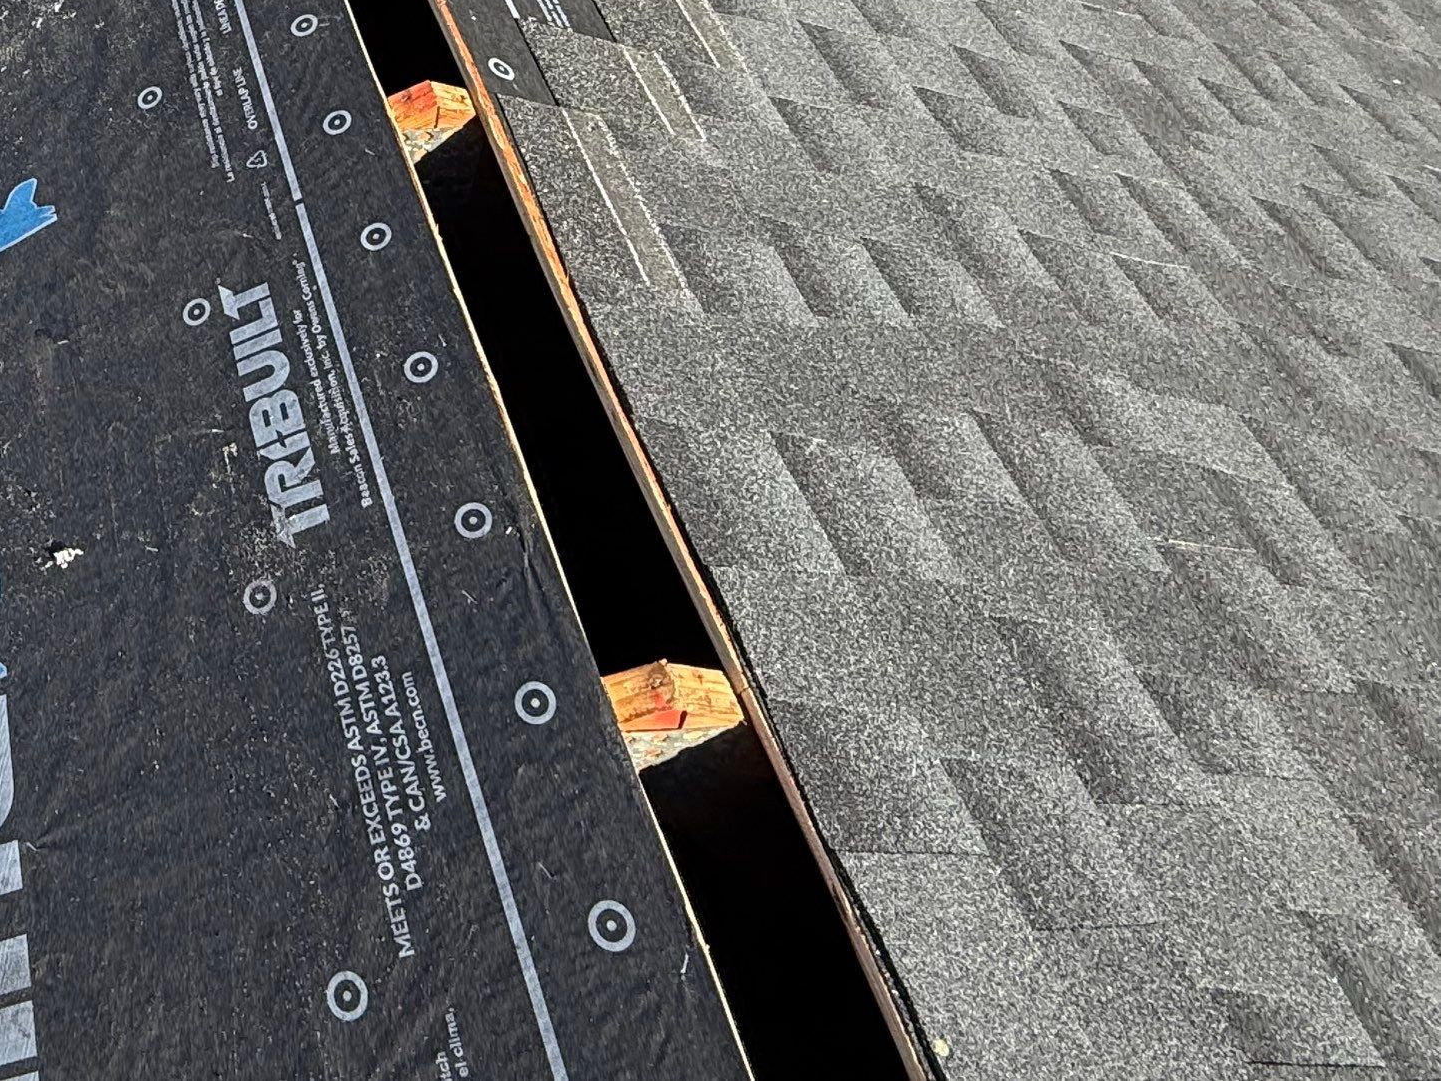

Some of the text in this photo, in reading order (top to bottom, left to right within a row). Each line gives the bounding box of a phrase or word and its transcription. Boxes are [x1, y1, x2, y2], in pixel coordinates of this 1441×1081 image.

[232, 67, 257, 129] OVERLAP LINE
[305, 300, 321, 333] Owens
[314, 334, 327, 349] by
[291, 309, 340, 453] Manufactured exclusively for
[328, 370, 353, 433] Acquisition,
[219, 280, 331, 549] TRIBUILT
[344, 432, 361, 463] Sales
[354, 464, 373, 507] Beacon
[313, 602, 335, 649] TYPE
[325, 649, 349, 695] D226
[337, 697, 363, 751] ASTM
[371, 656, 431, 831] & CAN/CSA A123.3
[403, 672, 445, 801] www.becn.com
[340, 626, 421, 889] D4869 TYPE IV, ASTM D8257
[351, 755, 385, 843] EXCEEDS
[373, 847, 395, 881] OR
[383, 883, 413, 957] MEETS
[445, 1008, 469, 1077] el clima,
